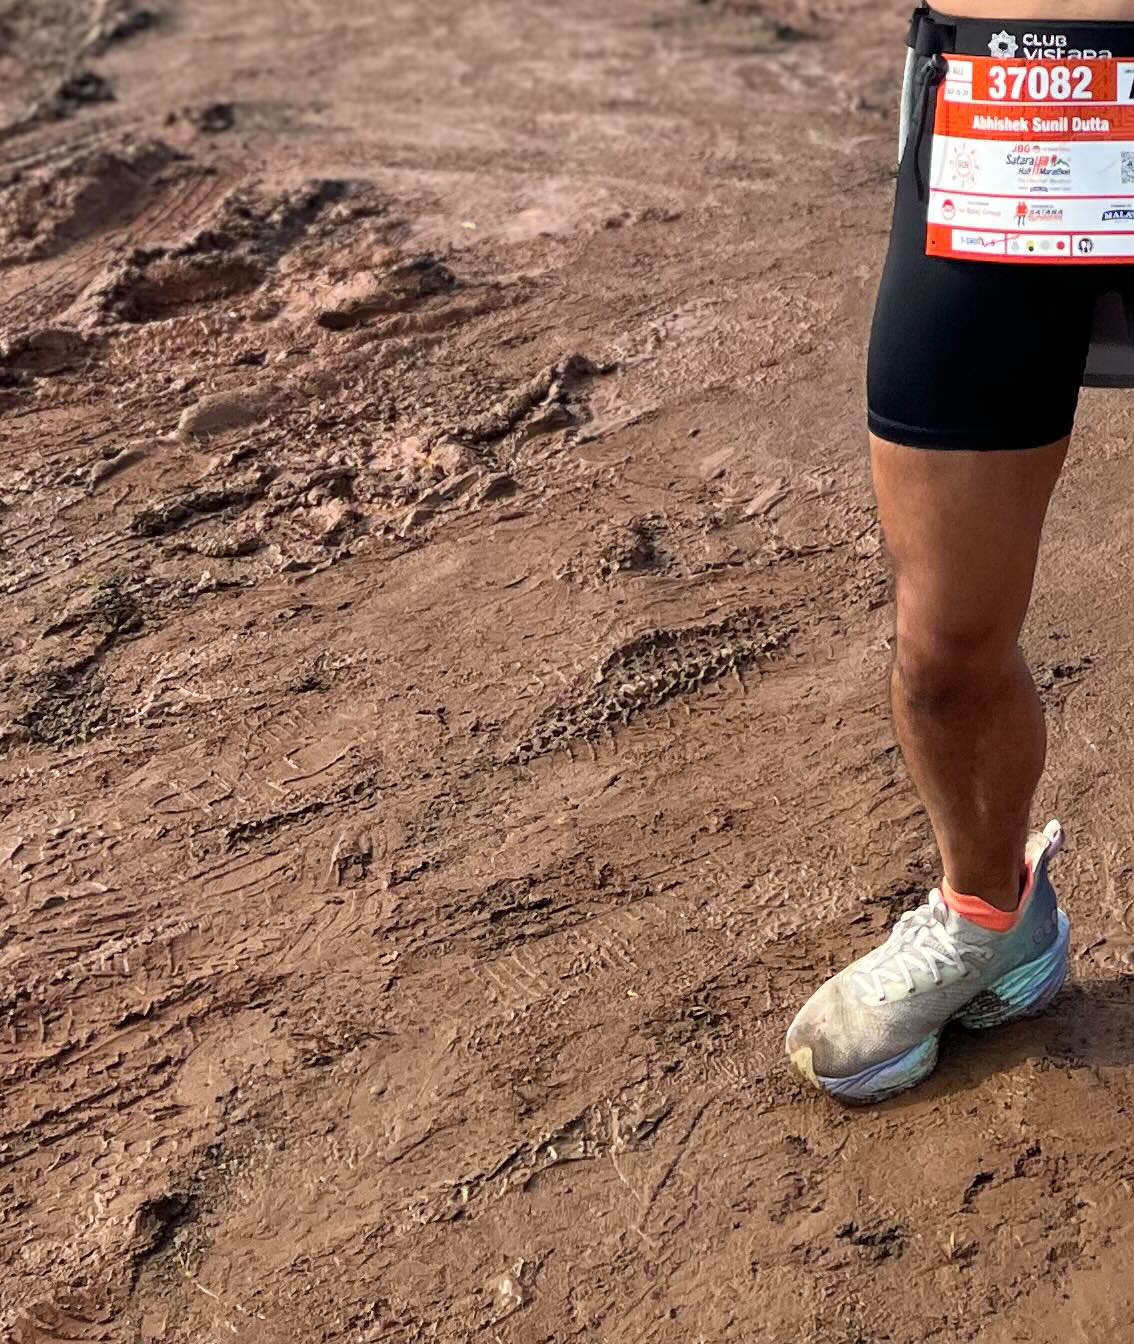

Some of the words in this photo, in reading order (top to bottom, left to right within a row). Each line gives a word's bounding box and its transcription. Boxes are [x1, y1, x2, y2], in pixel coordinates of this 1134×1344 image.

[1023, 33, 1067, 47] CLUB
[988, 65, 1092, 100] 37082
[972, 115, 1028, 131] Abhishek
[1032, 116, 1068, 132] Sunil
[1072, 117, 1110, 132] Dutta
[1006, 154, 1034, 165] Satara
[1040, 167, 1071, 175] Marathon
